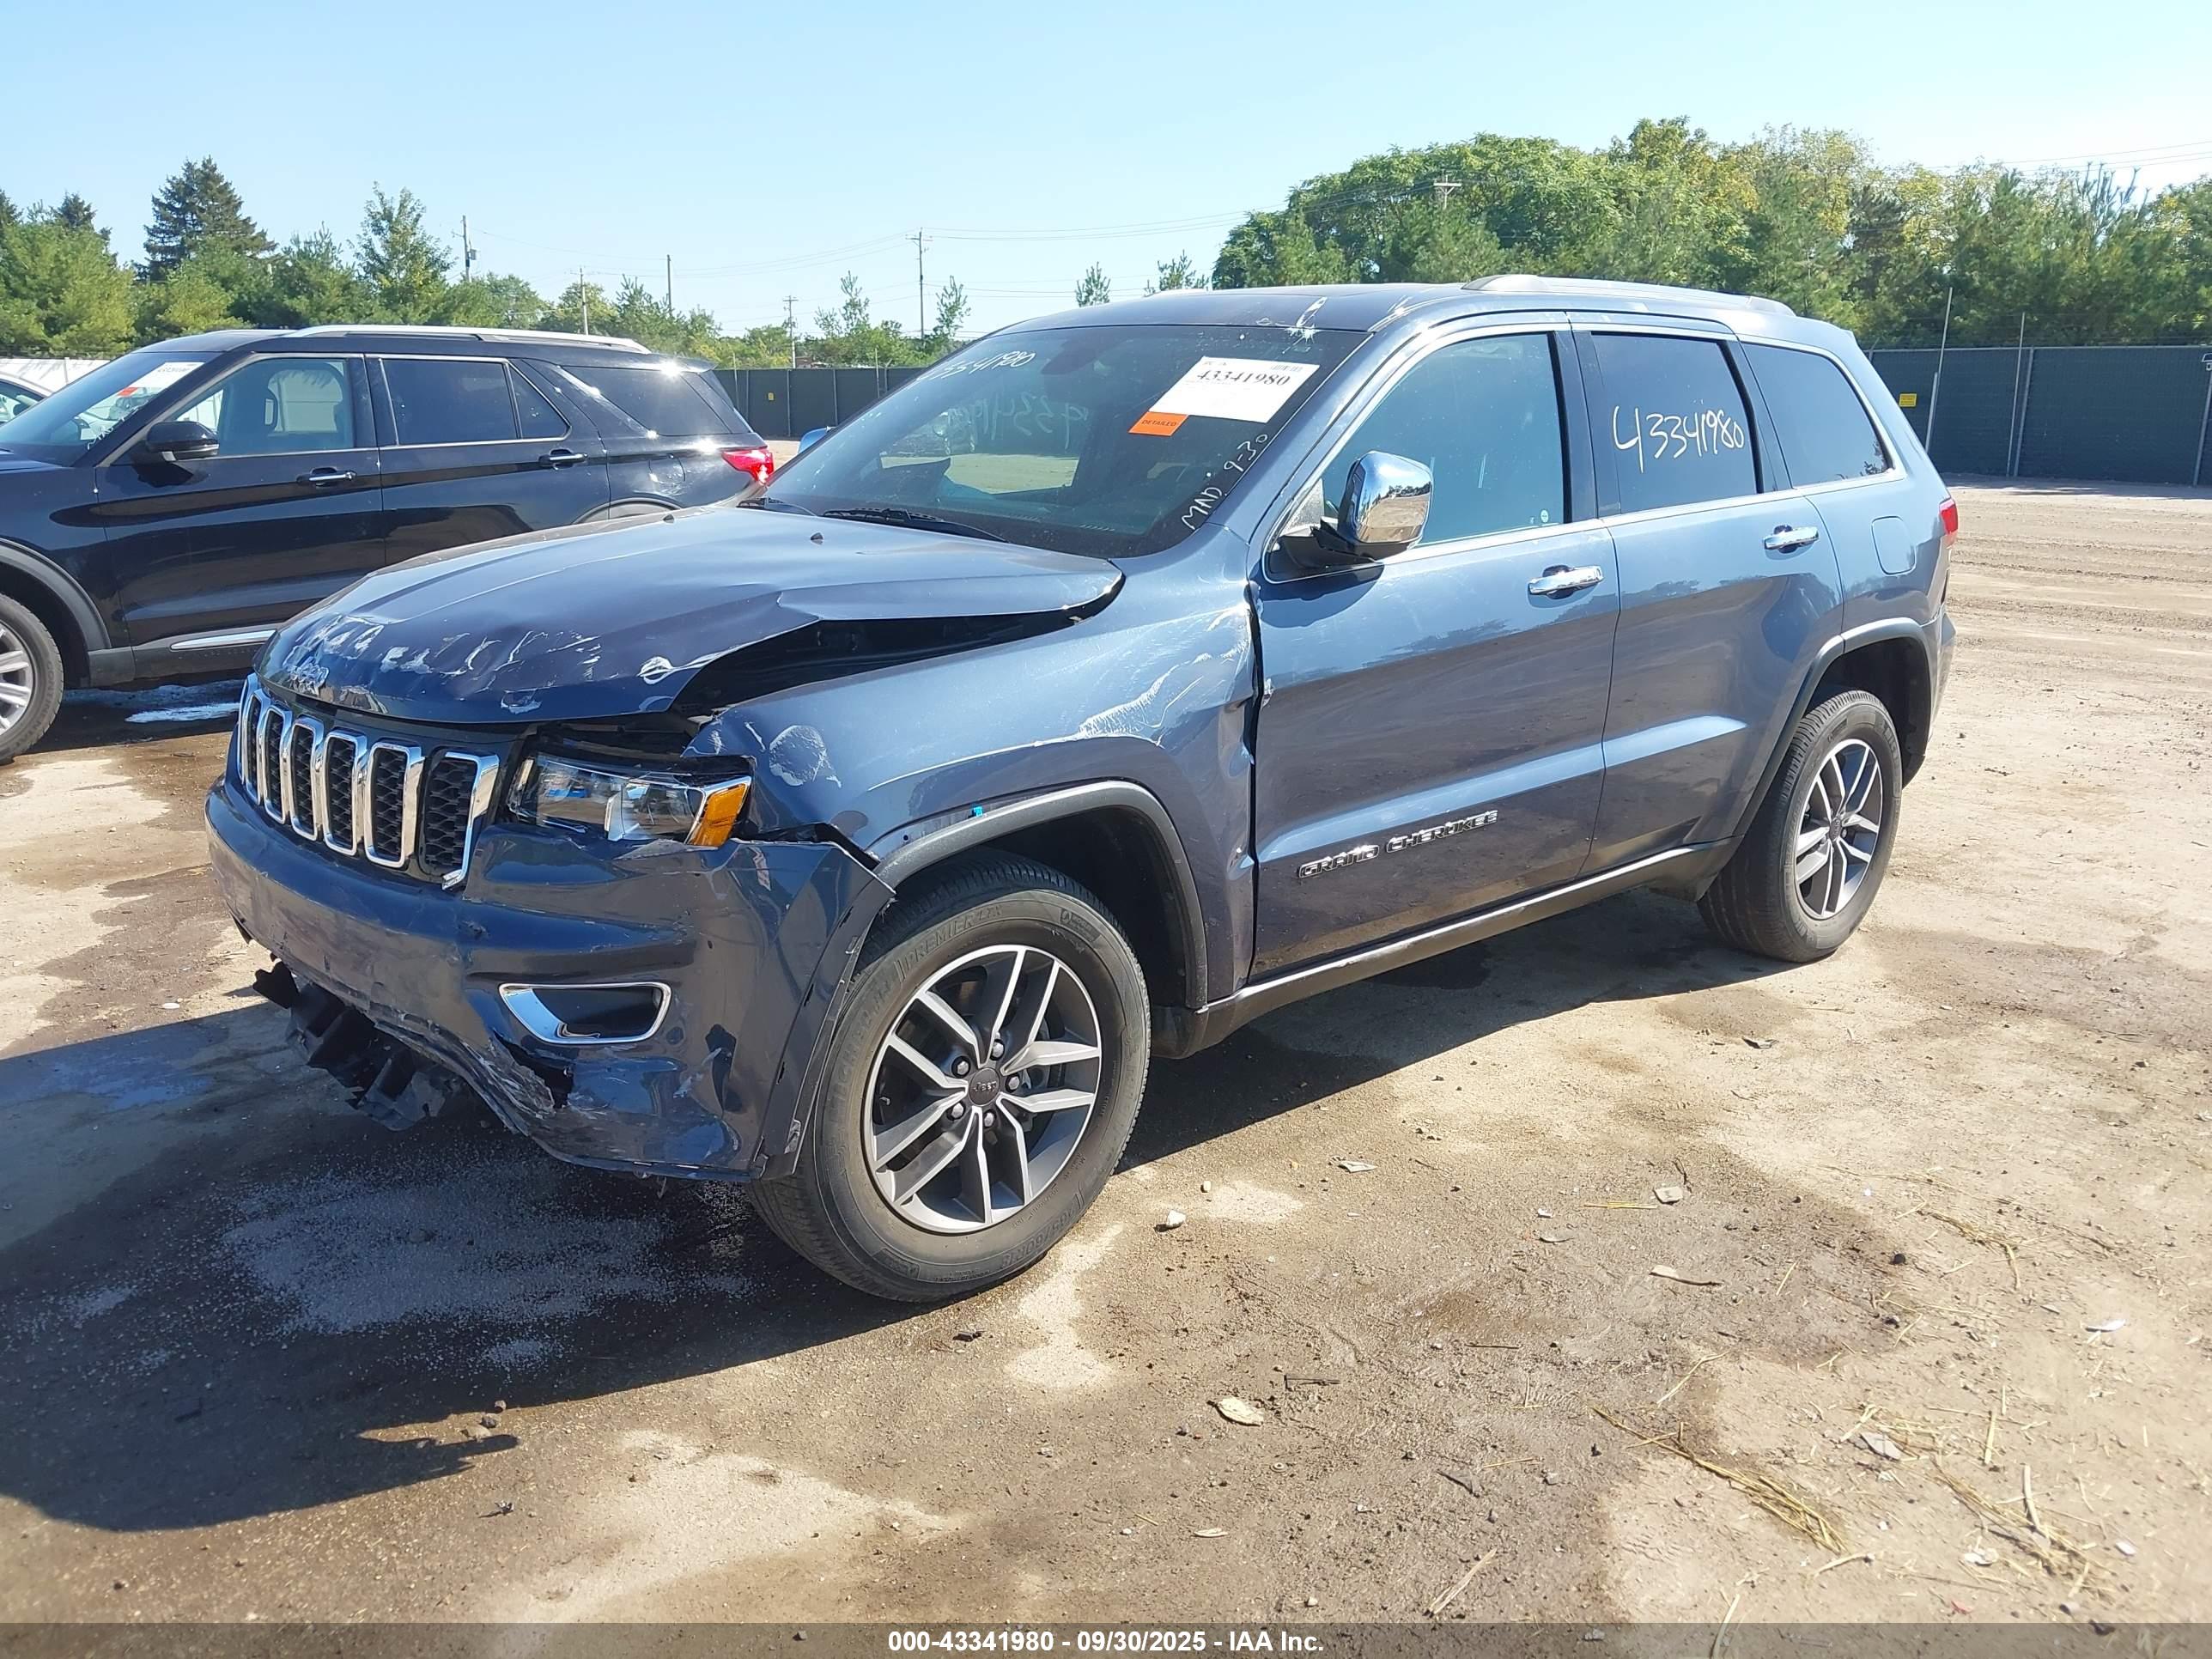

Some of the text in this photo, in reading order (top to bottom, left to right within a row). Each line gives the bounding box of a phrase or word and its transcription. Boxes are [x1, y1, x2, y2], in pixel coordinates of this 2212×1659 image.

[1197, 369, 1291, 386] 43341980
[1223, 434, 1268, 472] 9-30
[1613, 405, 1745, 473] 43341980
[1297, 810, 1498, 878] GRAND CHEROKEE
